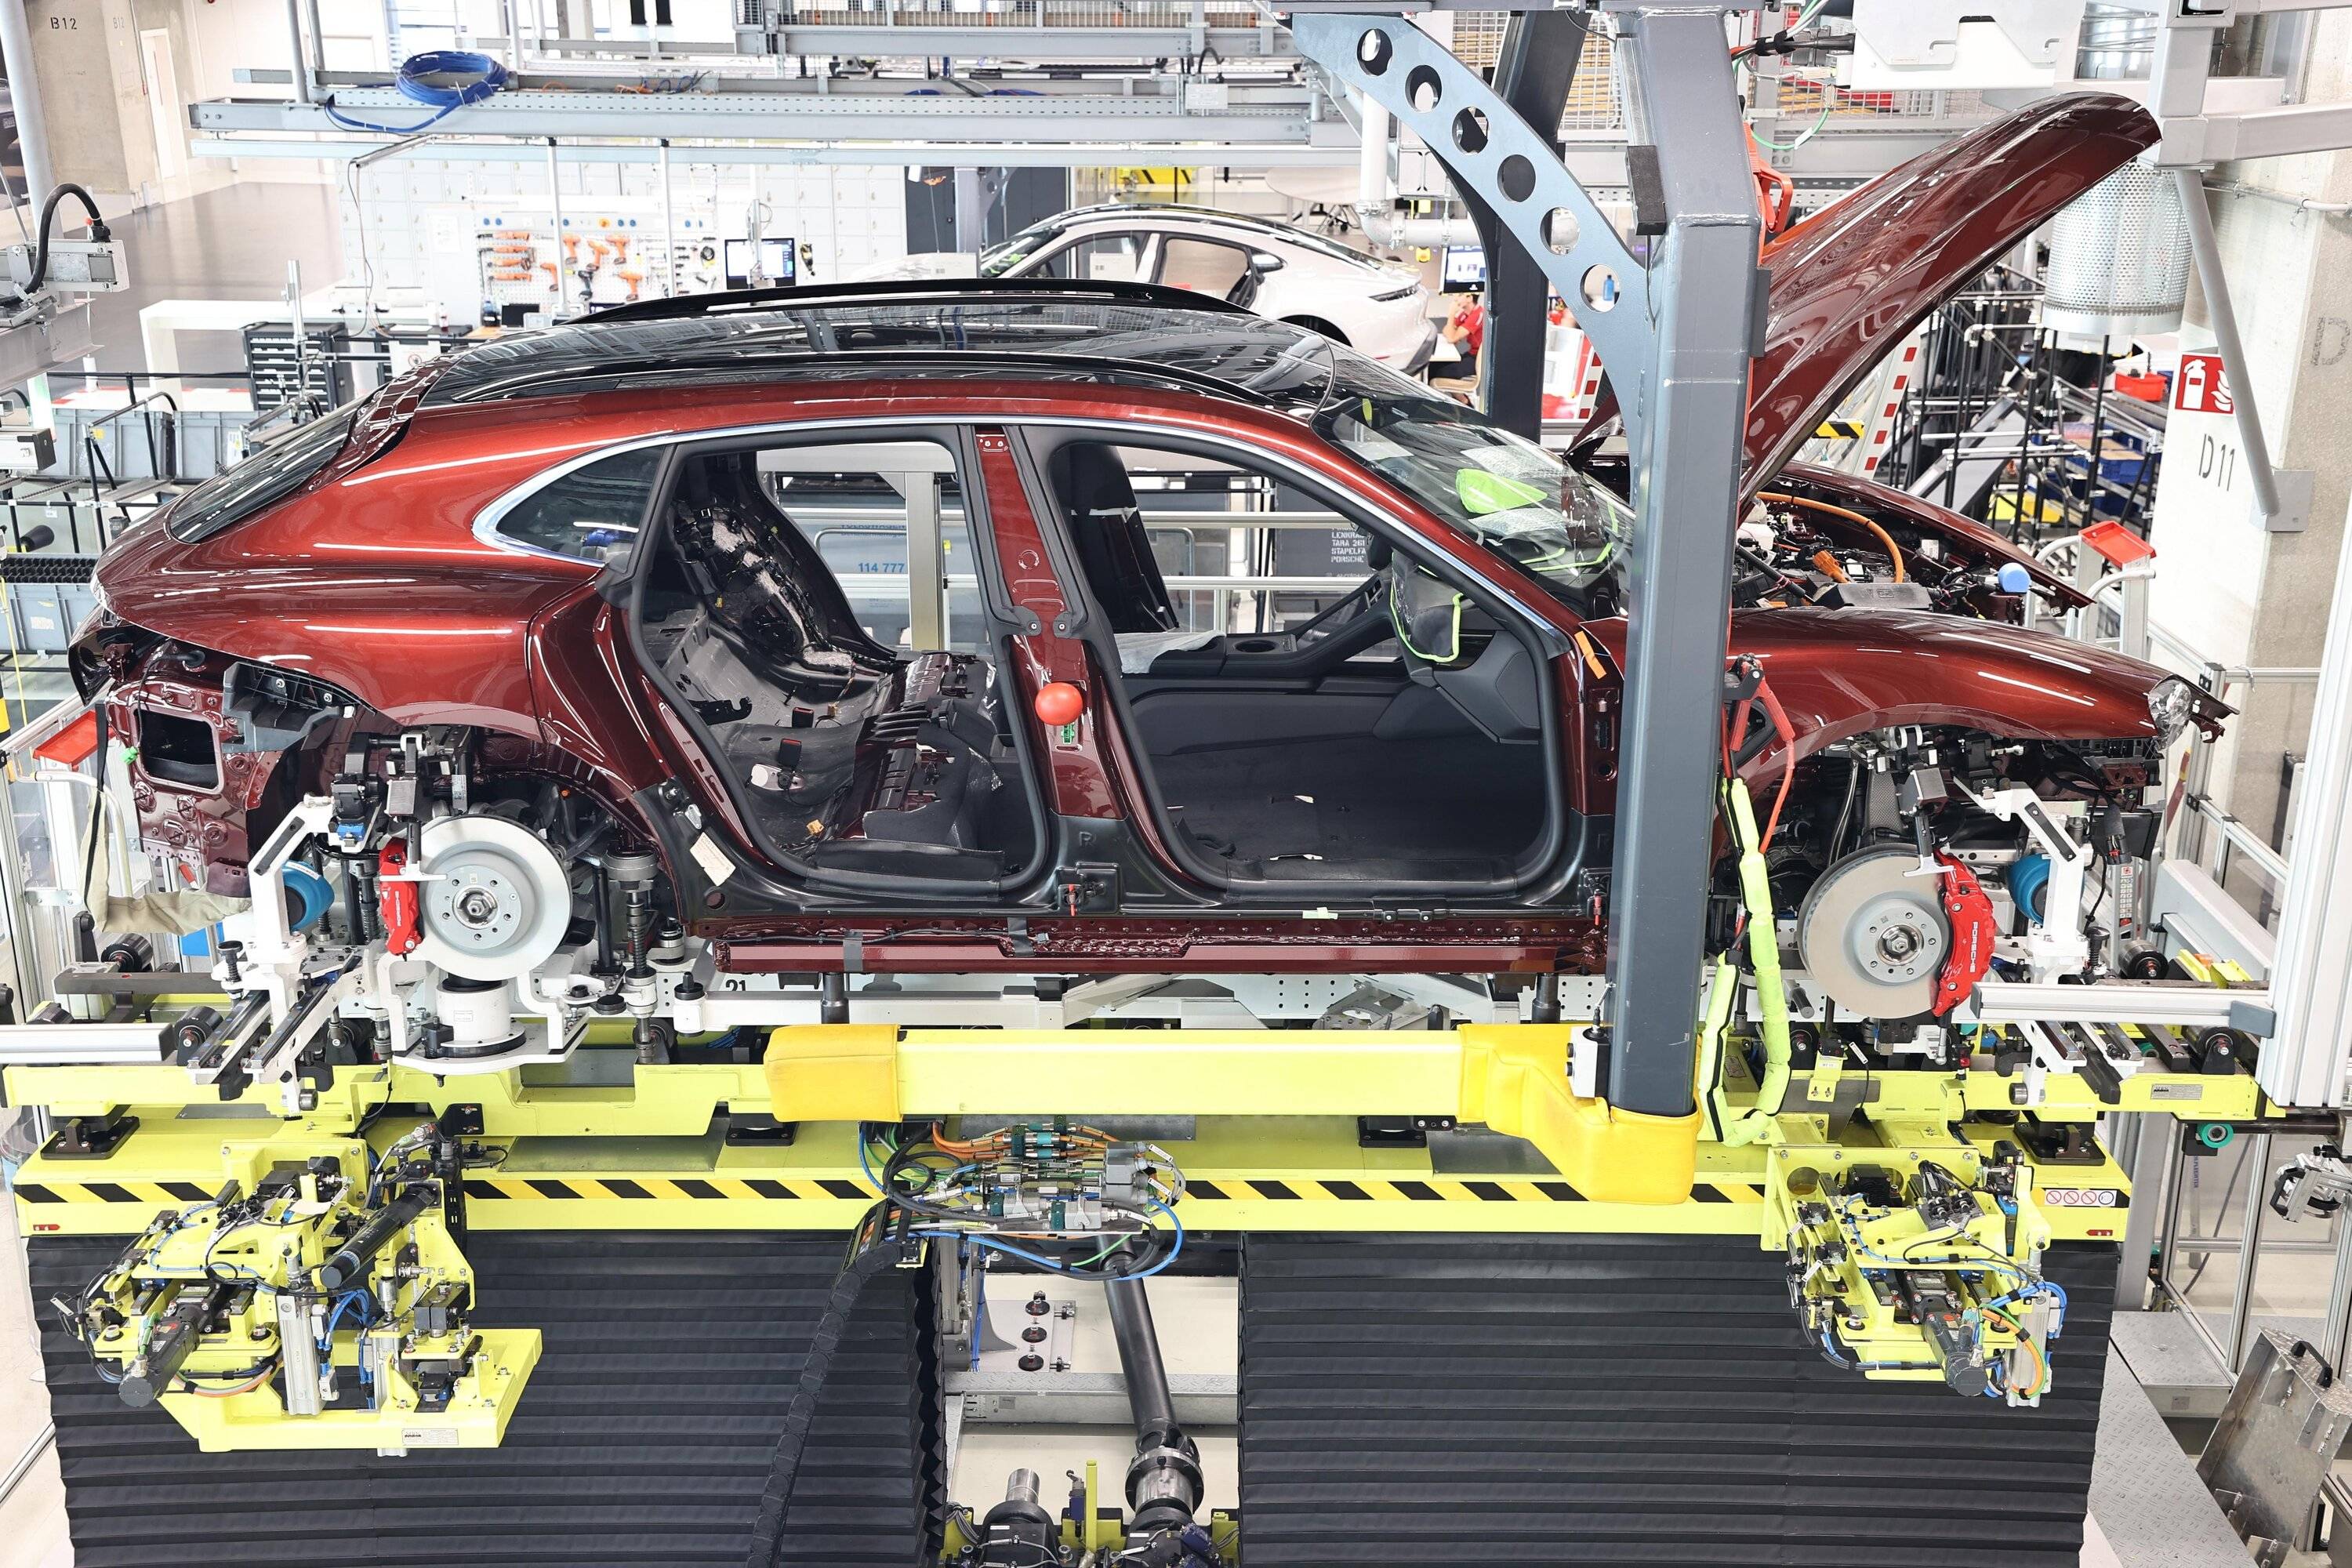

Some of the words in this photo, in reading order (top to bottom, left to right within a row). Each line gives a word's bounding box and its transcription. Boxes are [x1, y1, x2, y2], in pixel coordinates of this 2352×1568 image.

[50, 16, 78, 30] B12
[858, 562, 879, 573] 114
[883, 562, 906, 573] 777
[1969, 921, 1979, 973] PORSCHE
